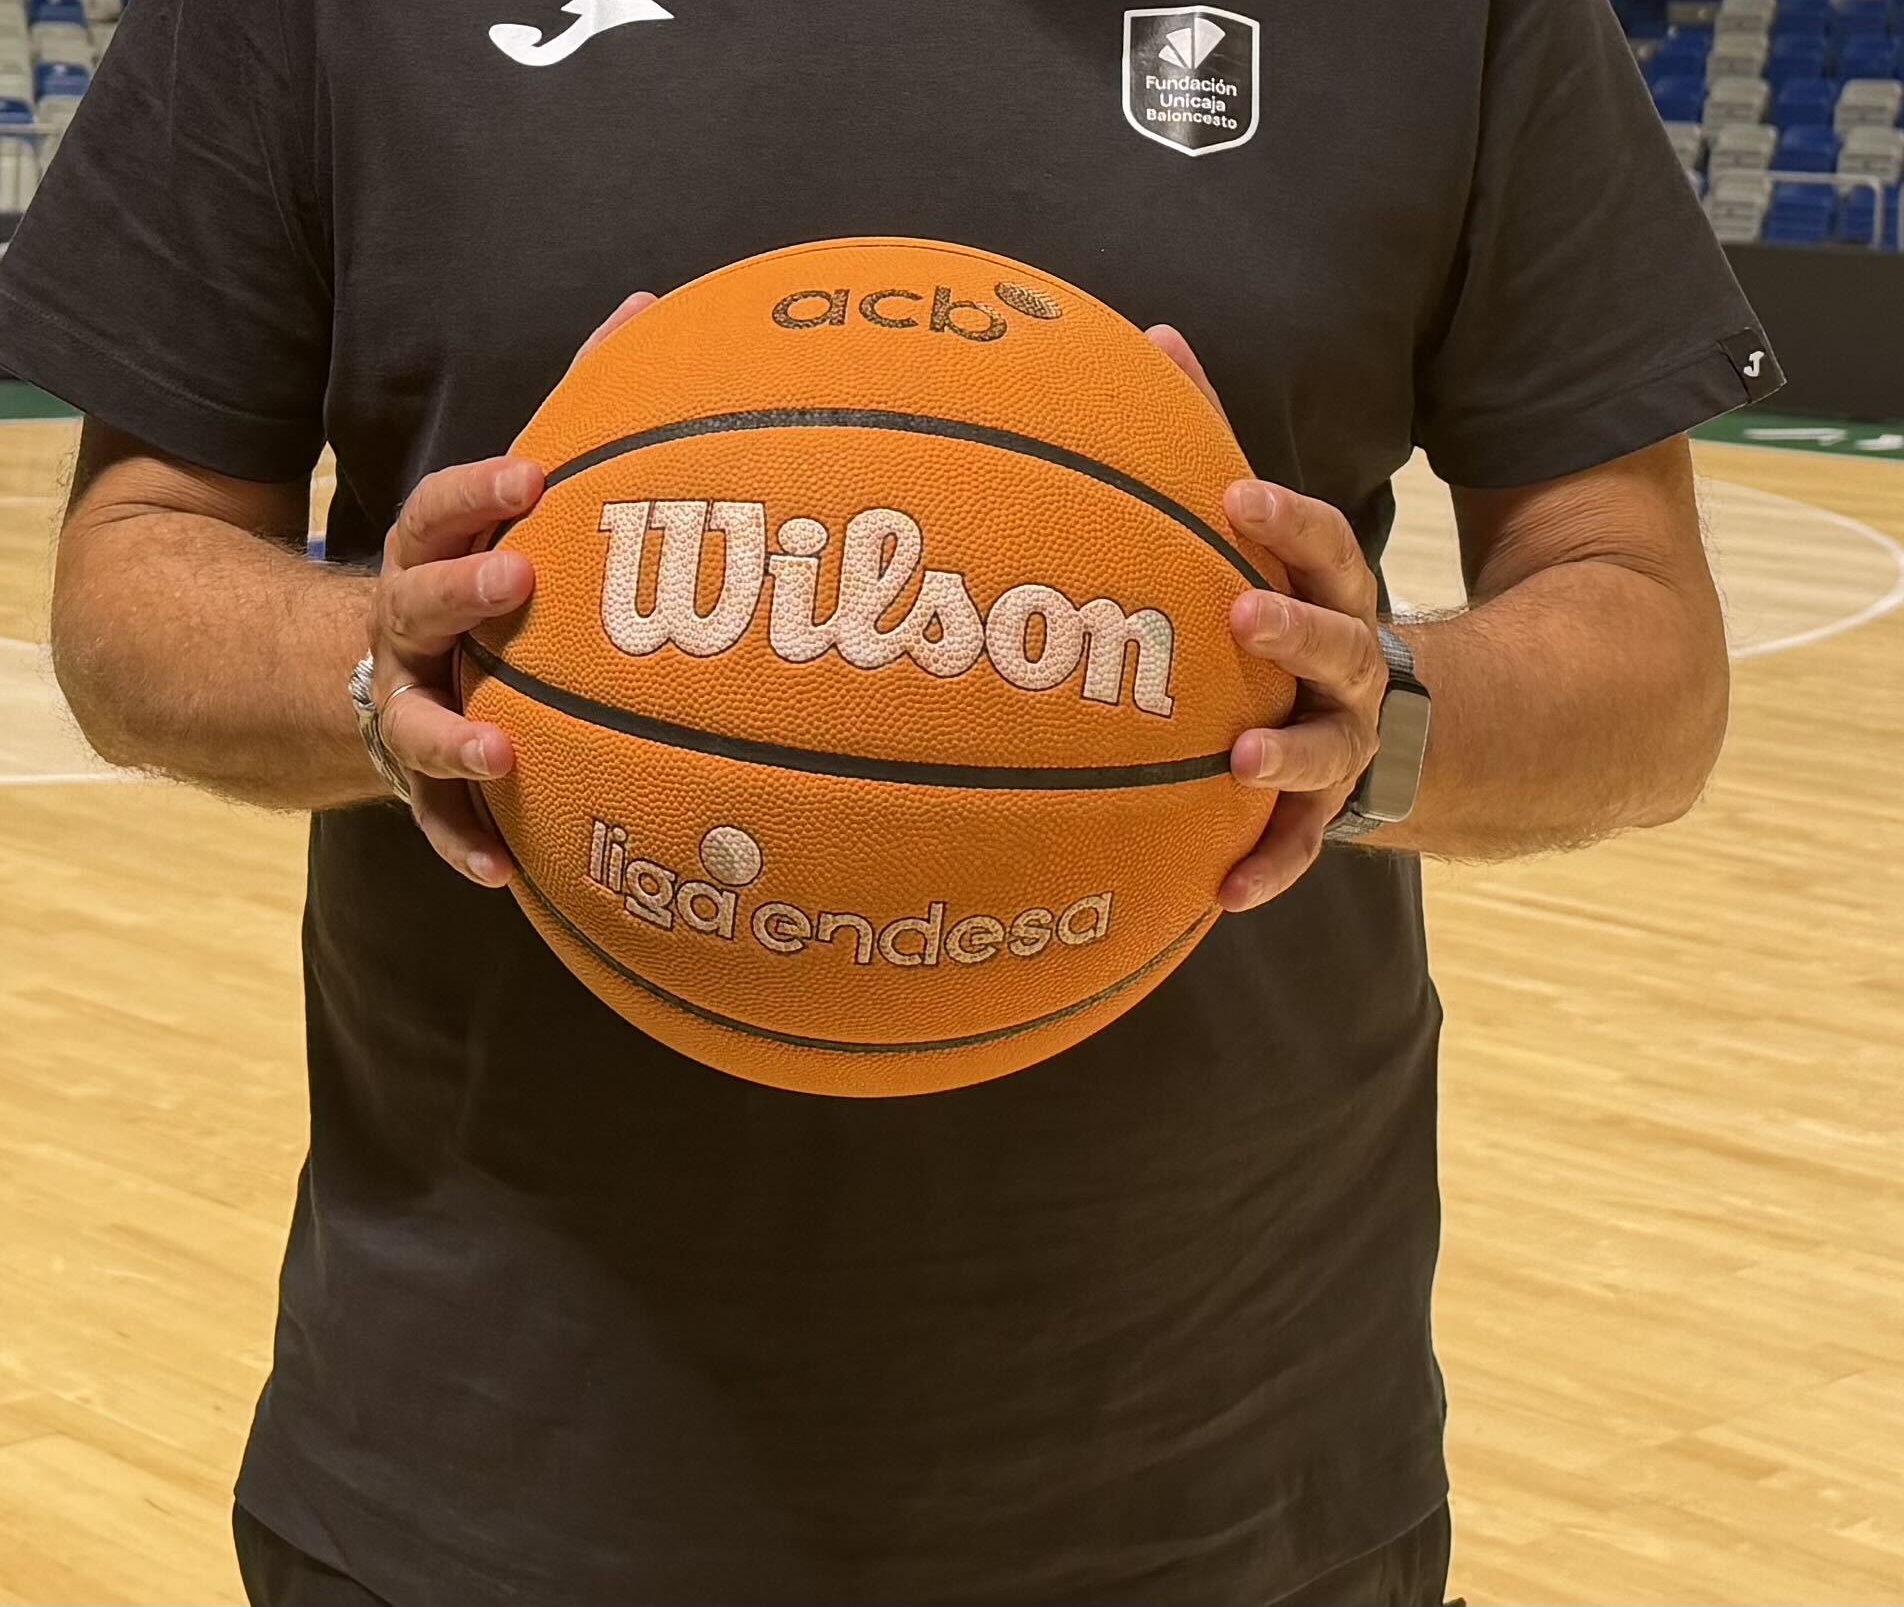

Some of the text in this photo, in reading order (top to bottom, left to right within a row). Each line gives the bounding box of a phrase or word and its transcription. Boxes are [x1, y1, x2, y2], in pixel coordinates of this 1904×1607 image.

[1145, 75, 1239, 98] Fundación
[1159, 92, 1227, 115] Unicaja
[1146, 107, 1239, 131] Baloncesto
[771, 283, 1008, 344] acb
[598, 497, 1175, 720] Wilson
[584, 816, 1113, 969] liga endesa
